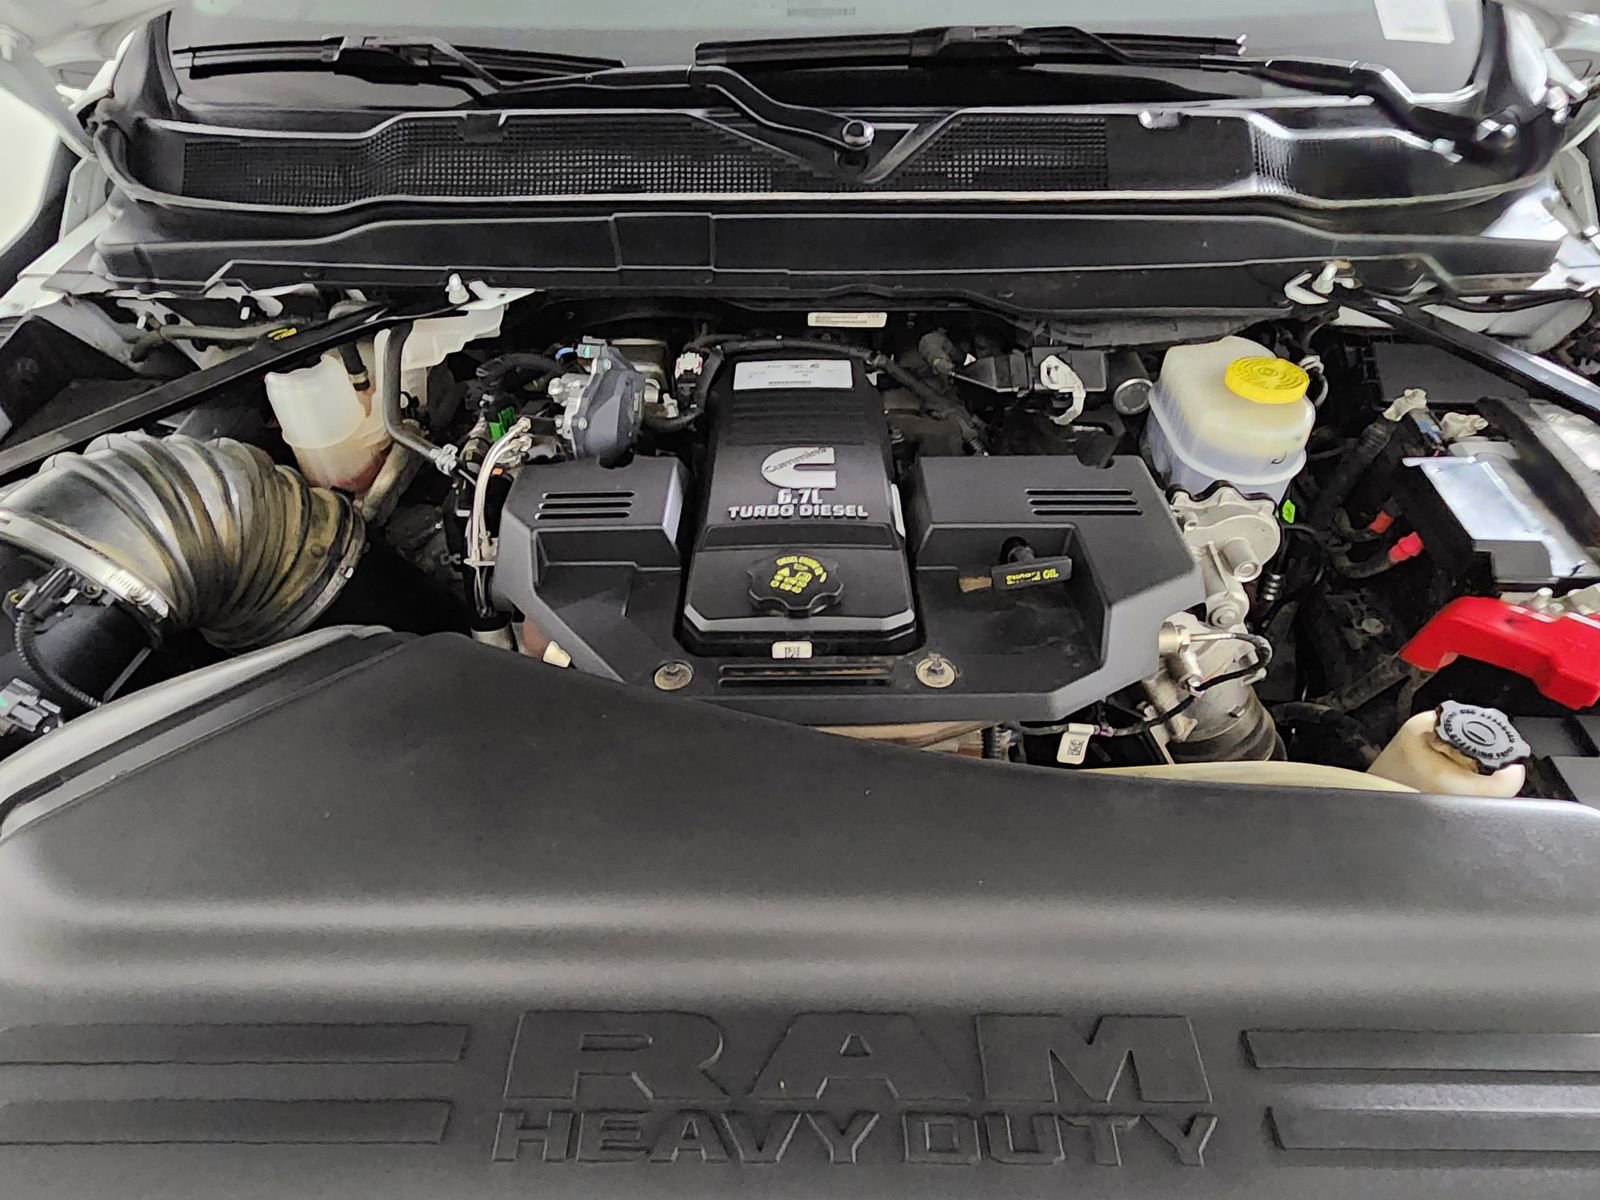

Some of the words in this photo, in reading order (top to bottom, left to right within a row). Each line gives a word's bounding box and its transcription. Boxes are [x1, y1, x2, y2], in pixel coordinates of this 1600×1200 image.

[728, 504, 795, 519] TURBO
[799, 504, 869, 518] DIESEL
[777, 488, 824, 505] 6.7L
[503, 1010, 1213, 1103] RAM
[491, 1107, 880, 1164] HEAVY
[900, 1109, 1218, 1167] DUTY
